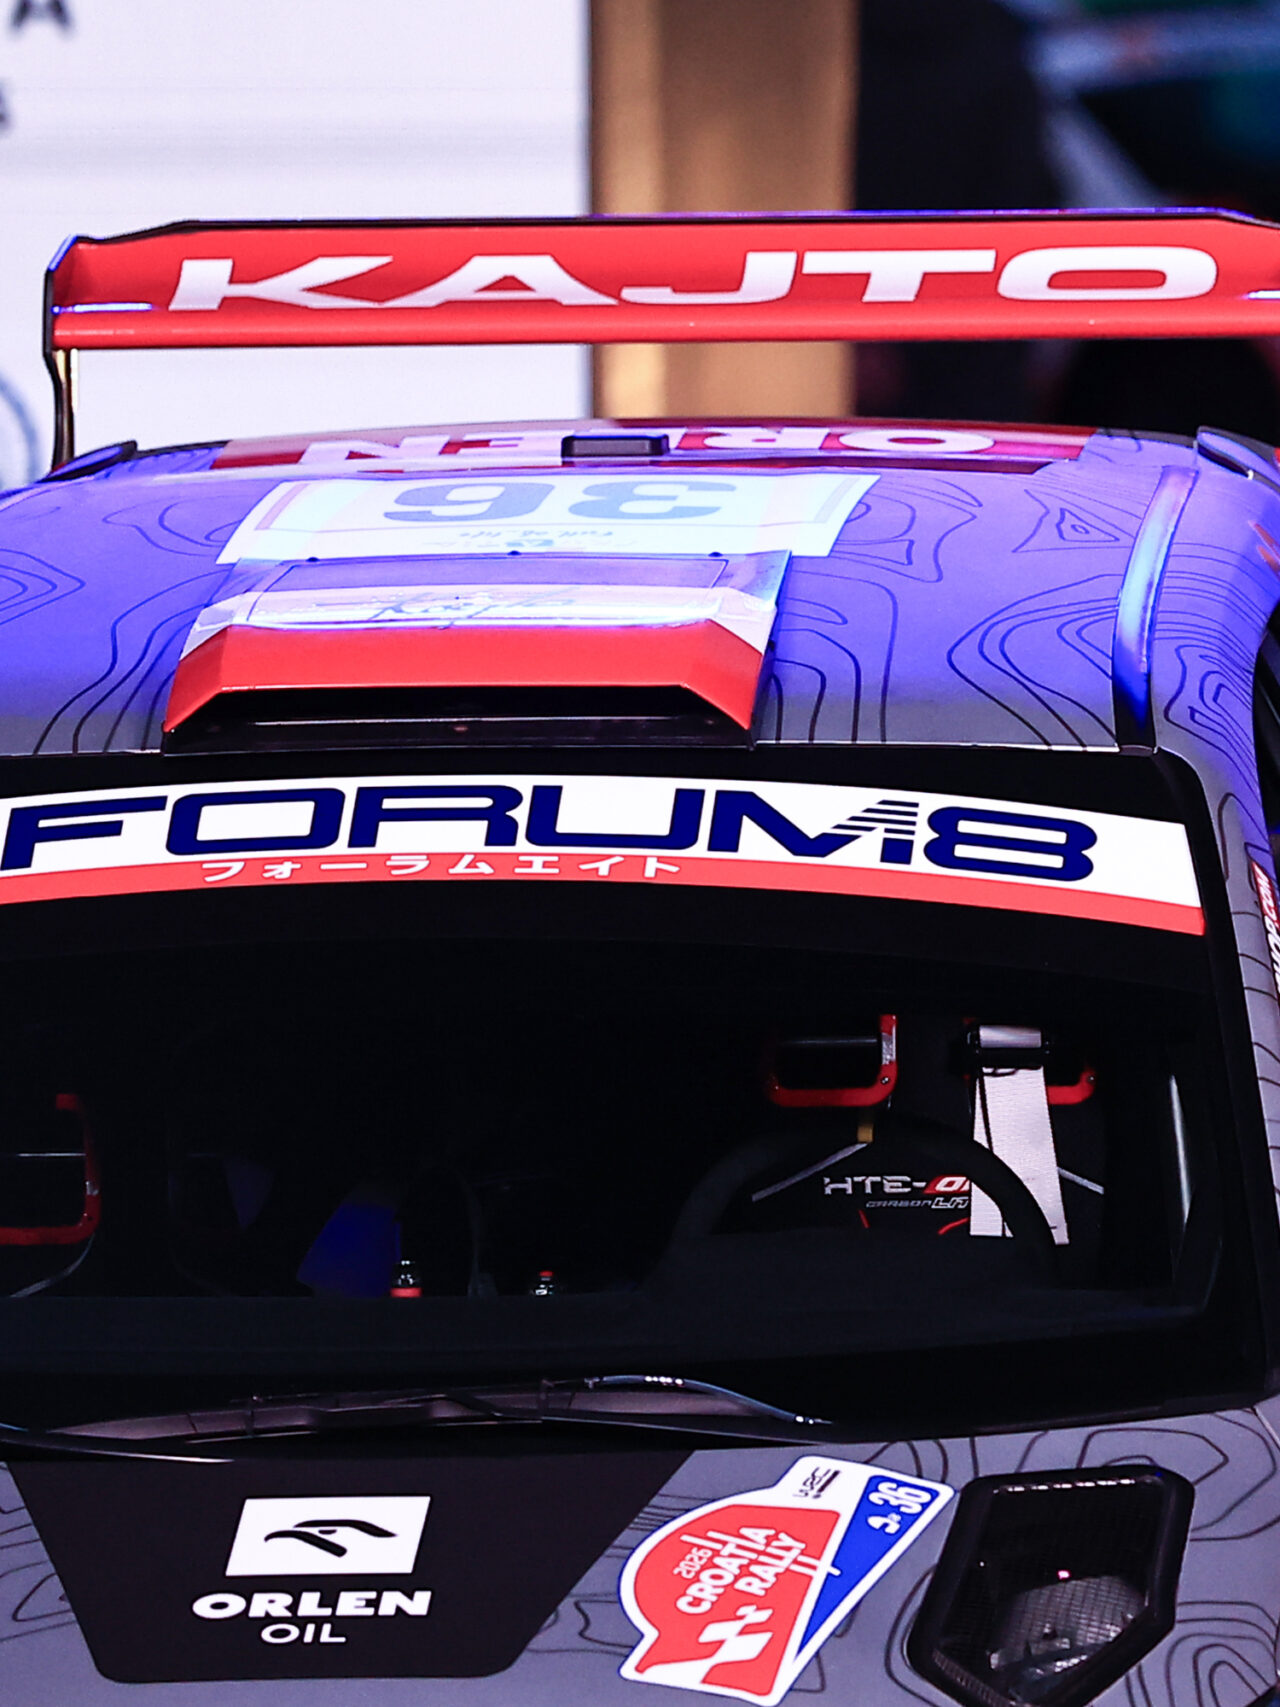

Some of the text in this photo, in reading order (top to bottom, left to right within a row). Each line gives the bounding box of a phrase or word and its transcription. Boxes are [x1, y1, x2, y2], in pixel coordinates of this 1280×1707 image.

[168, 246, 1218, 310] KAJTO
[0, 785, 1098, 882] FORUM8
[202, 854, 681, 883] フォーラムエイト
[868, 1481, 932, 1515] 36
[673, 1546, 713, 1579] 2026
[676, 1527, 776, 1615] CROATIA
[733, 1532, 806, 1597] RALLY
[192, 1590, 432, 1620] ORLEN
[261, 1623, 347, 1644] OIL
